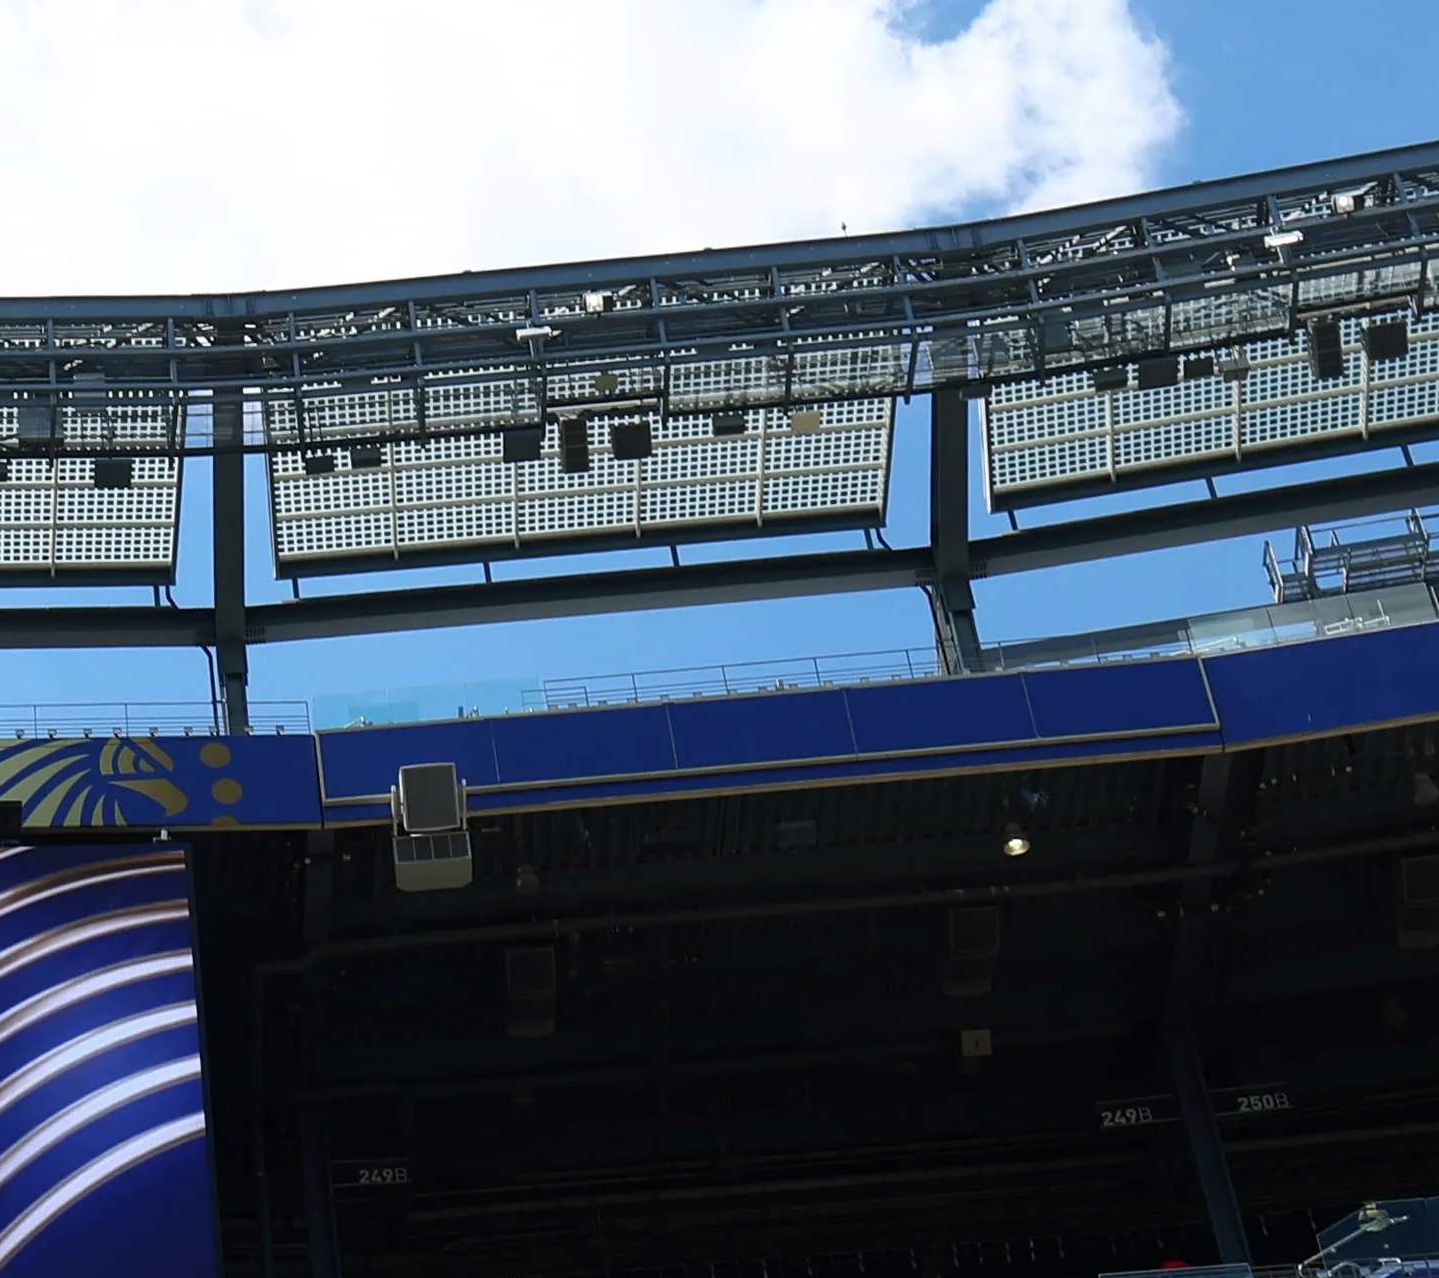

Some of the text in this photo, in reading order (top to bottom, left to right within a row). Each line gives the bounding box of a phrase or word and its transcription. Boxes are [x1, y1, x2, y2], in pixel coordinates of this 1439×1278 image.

[1237, 1092, 1291, 1113] 250B
[1100, 1105, 1154, 1128] 249B
[358, 1167, 408, 1185] 249B
